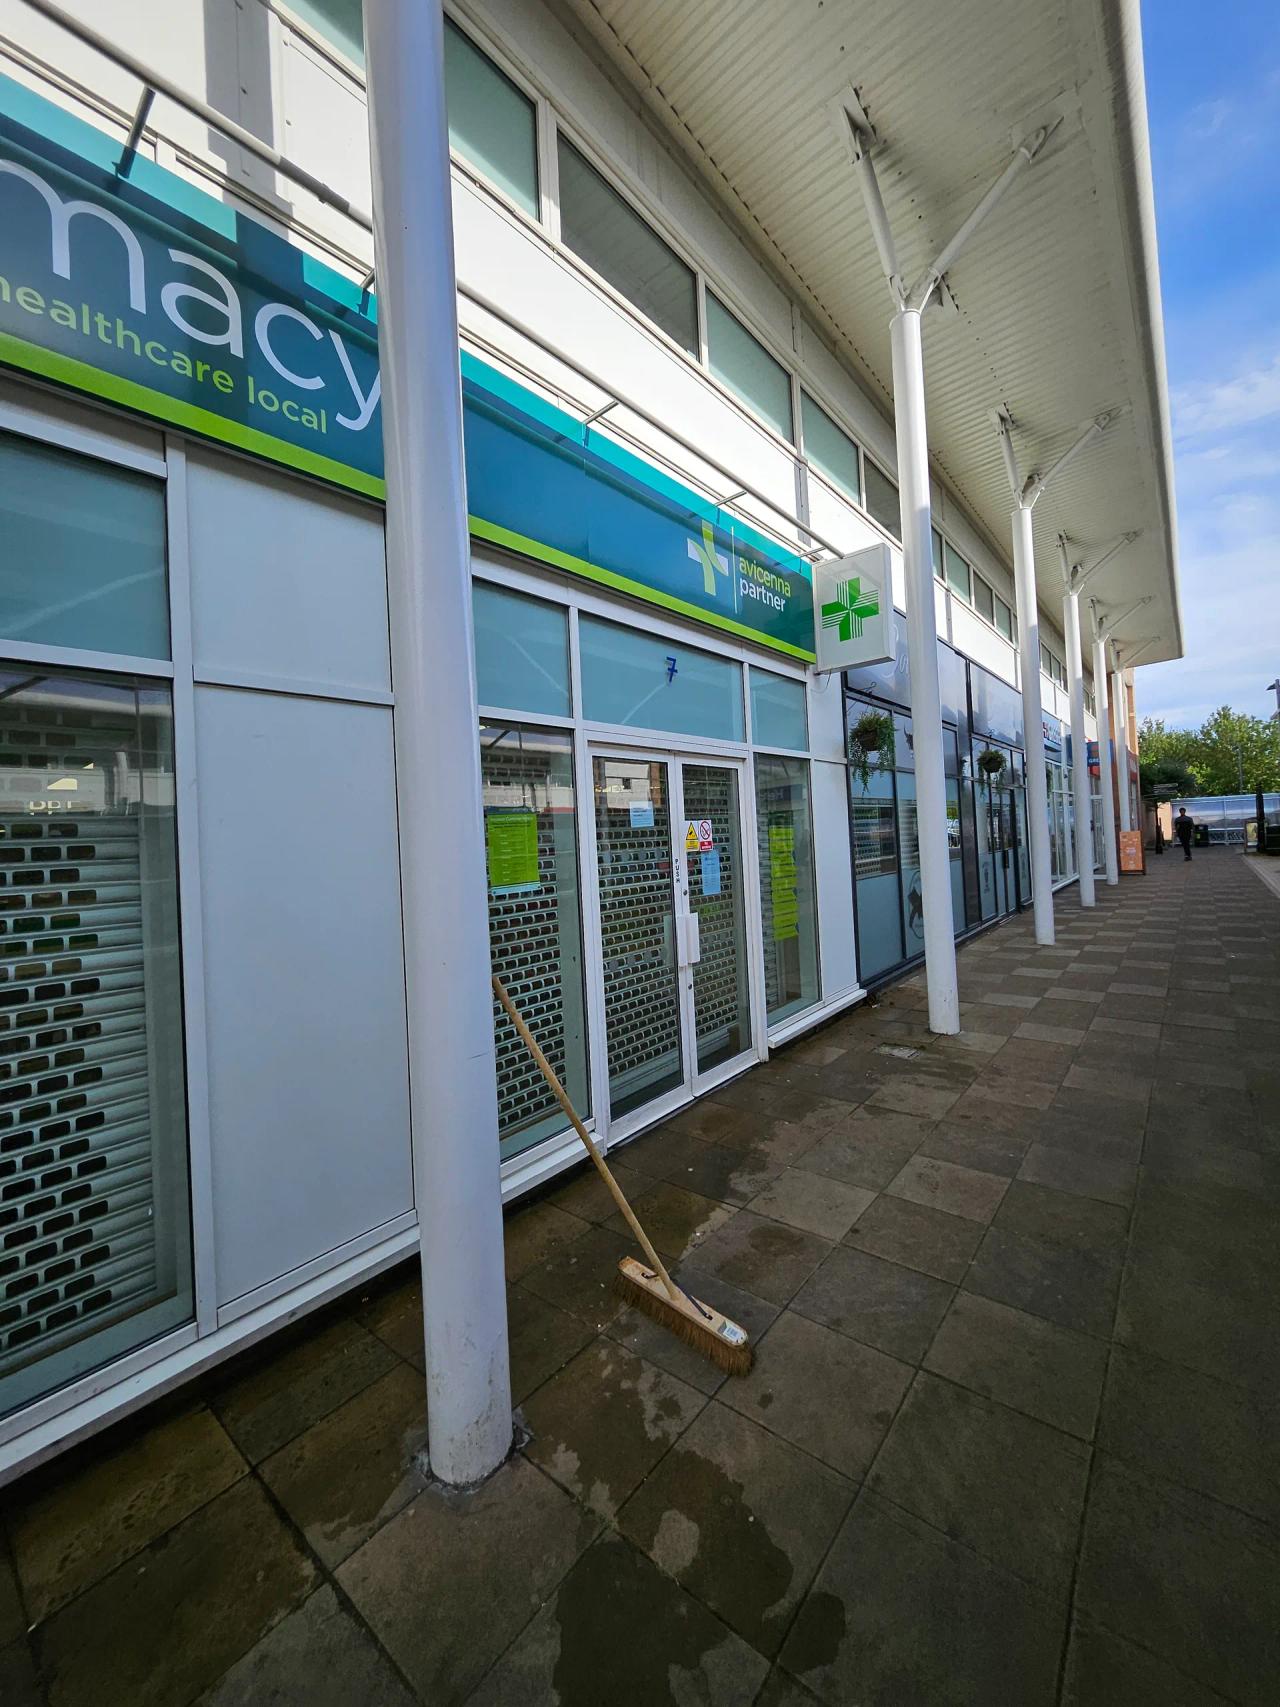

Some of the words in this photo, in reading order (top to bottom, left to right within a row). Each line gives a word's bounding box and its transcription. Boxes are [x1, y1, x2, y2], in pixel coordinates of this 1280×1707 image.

[247, 376, 328, 434] local
[739, 556, 791, 598] avicenna
[739, 577, 786, 612] partner
[666, 655, 679, 683] 7
